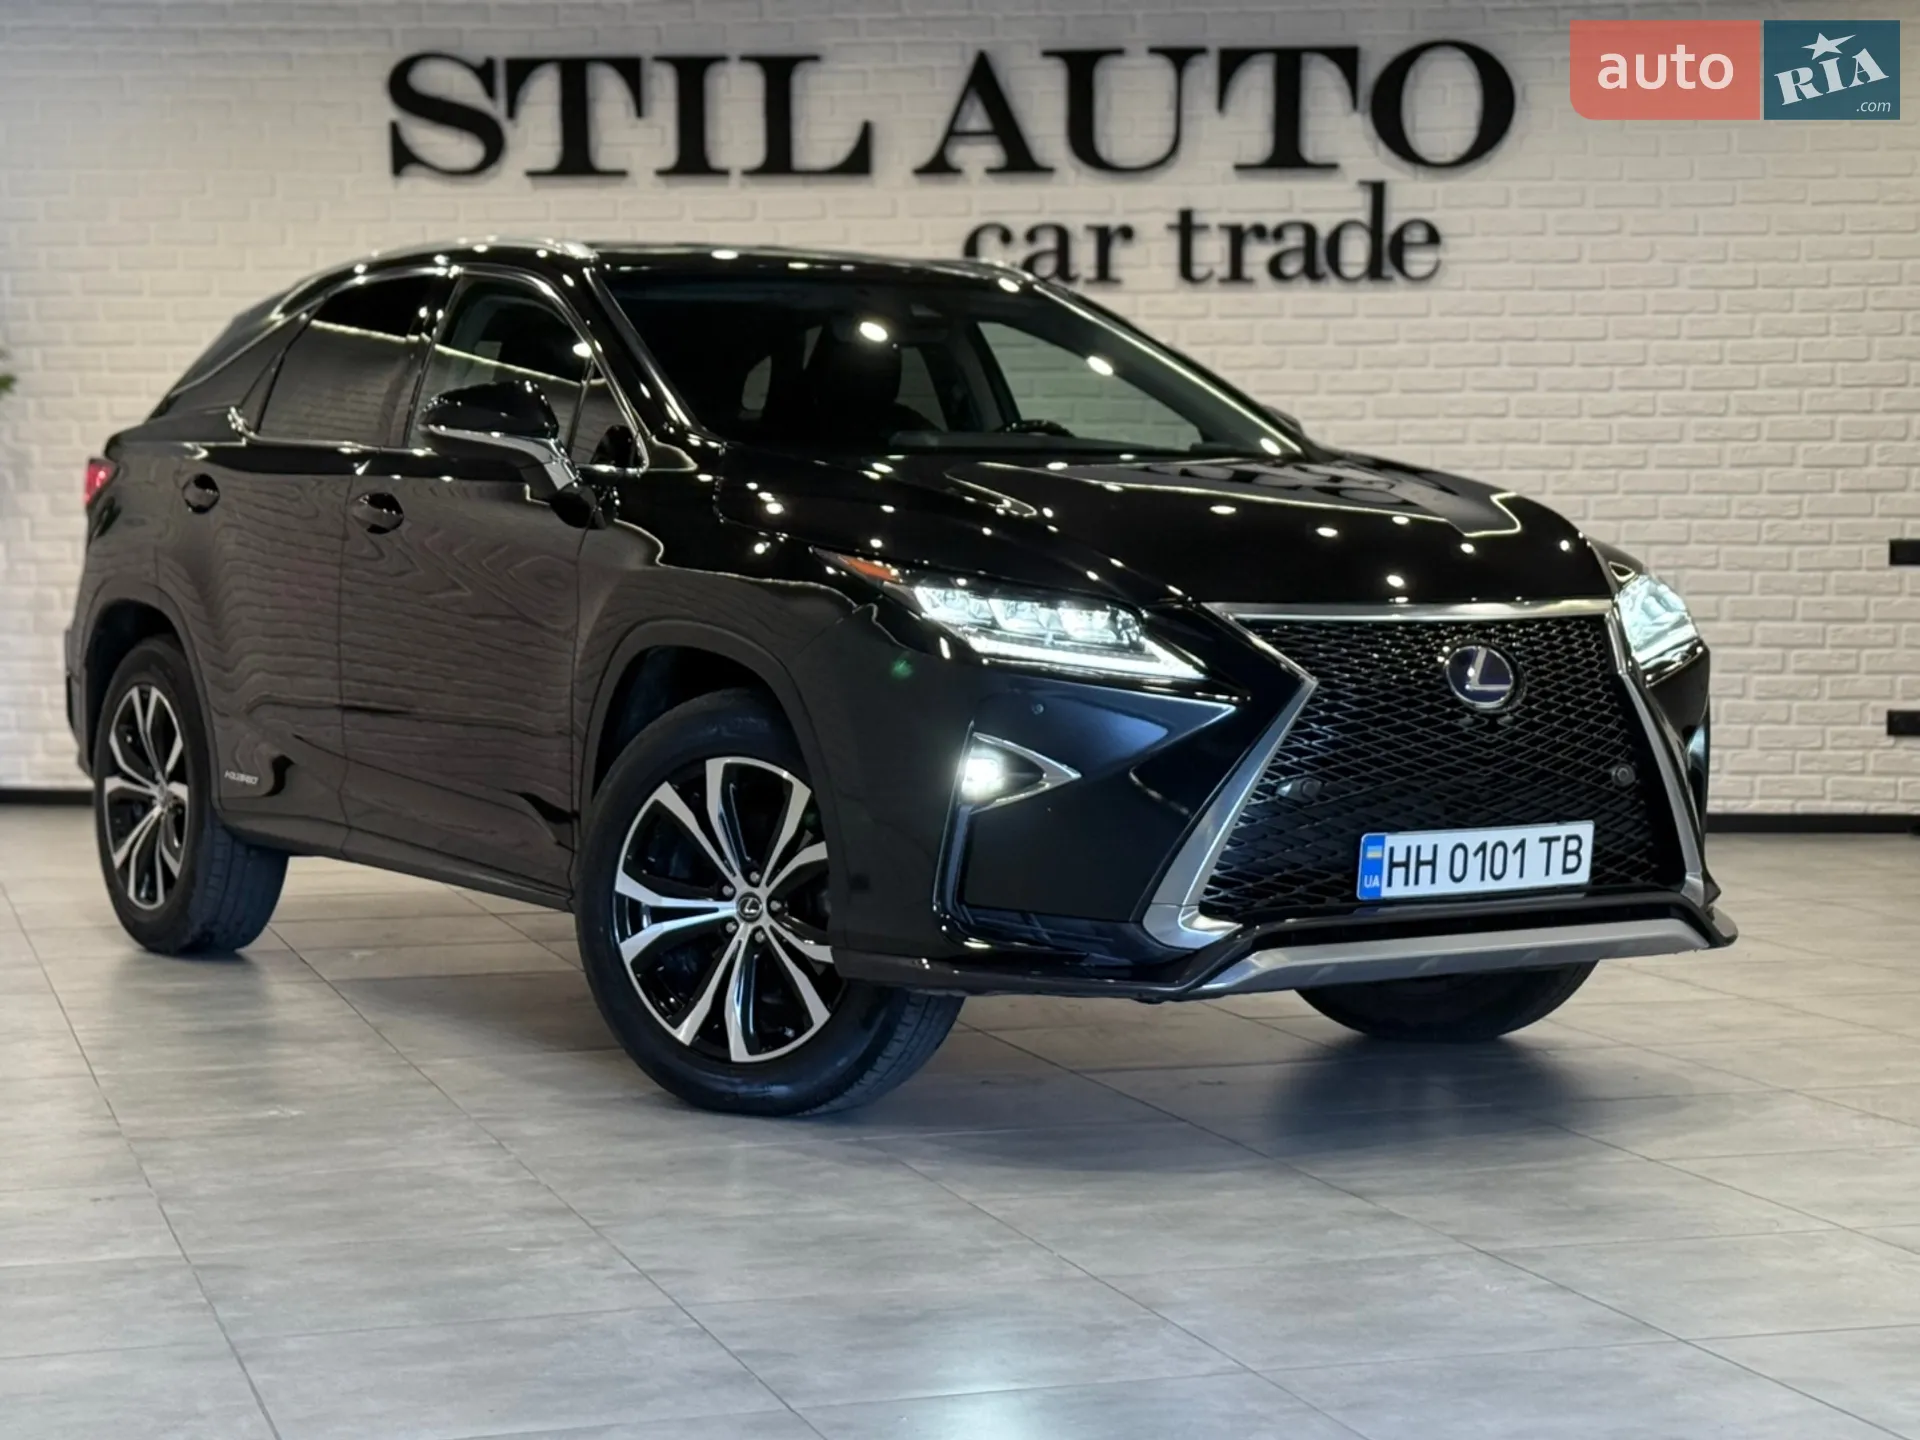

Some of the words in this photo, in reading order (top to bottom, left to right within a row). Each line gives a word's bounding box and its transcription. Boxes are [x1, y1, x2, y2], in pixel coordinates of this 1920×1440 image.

[387, 51, 873, 178] STIL
[913, 38, 1516, 176] AUTO
[963, 220, 1134, 284] car
[1165, 180, 1442, 283] trade
[1363, 874, 1380, 889] UA
[1386, 843, 1438, 888] HH
[1449, 837, 1527, 883] 0101
[1538, 834, 1583, 877] TB
